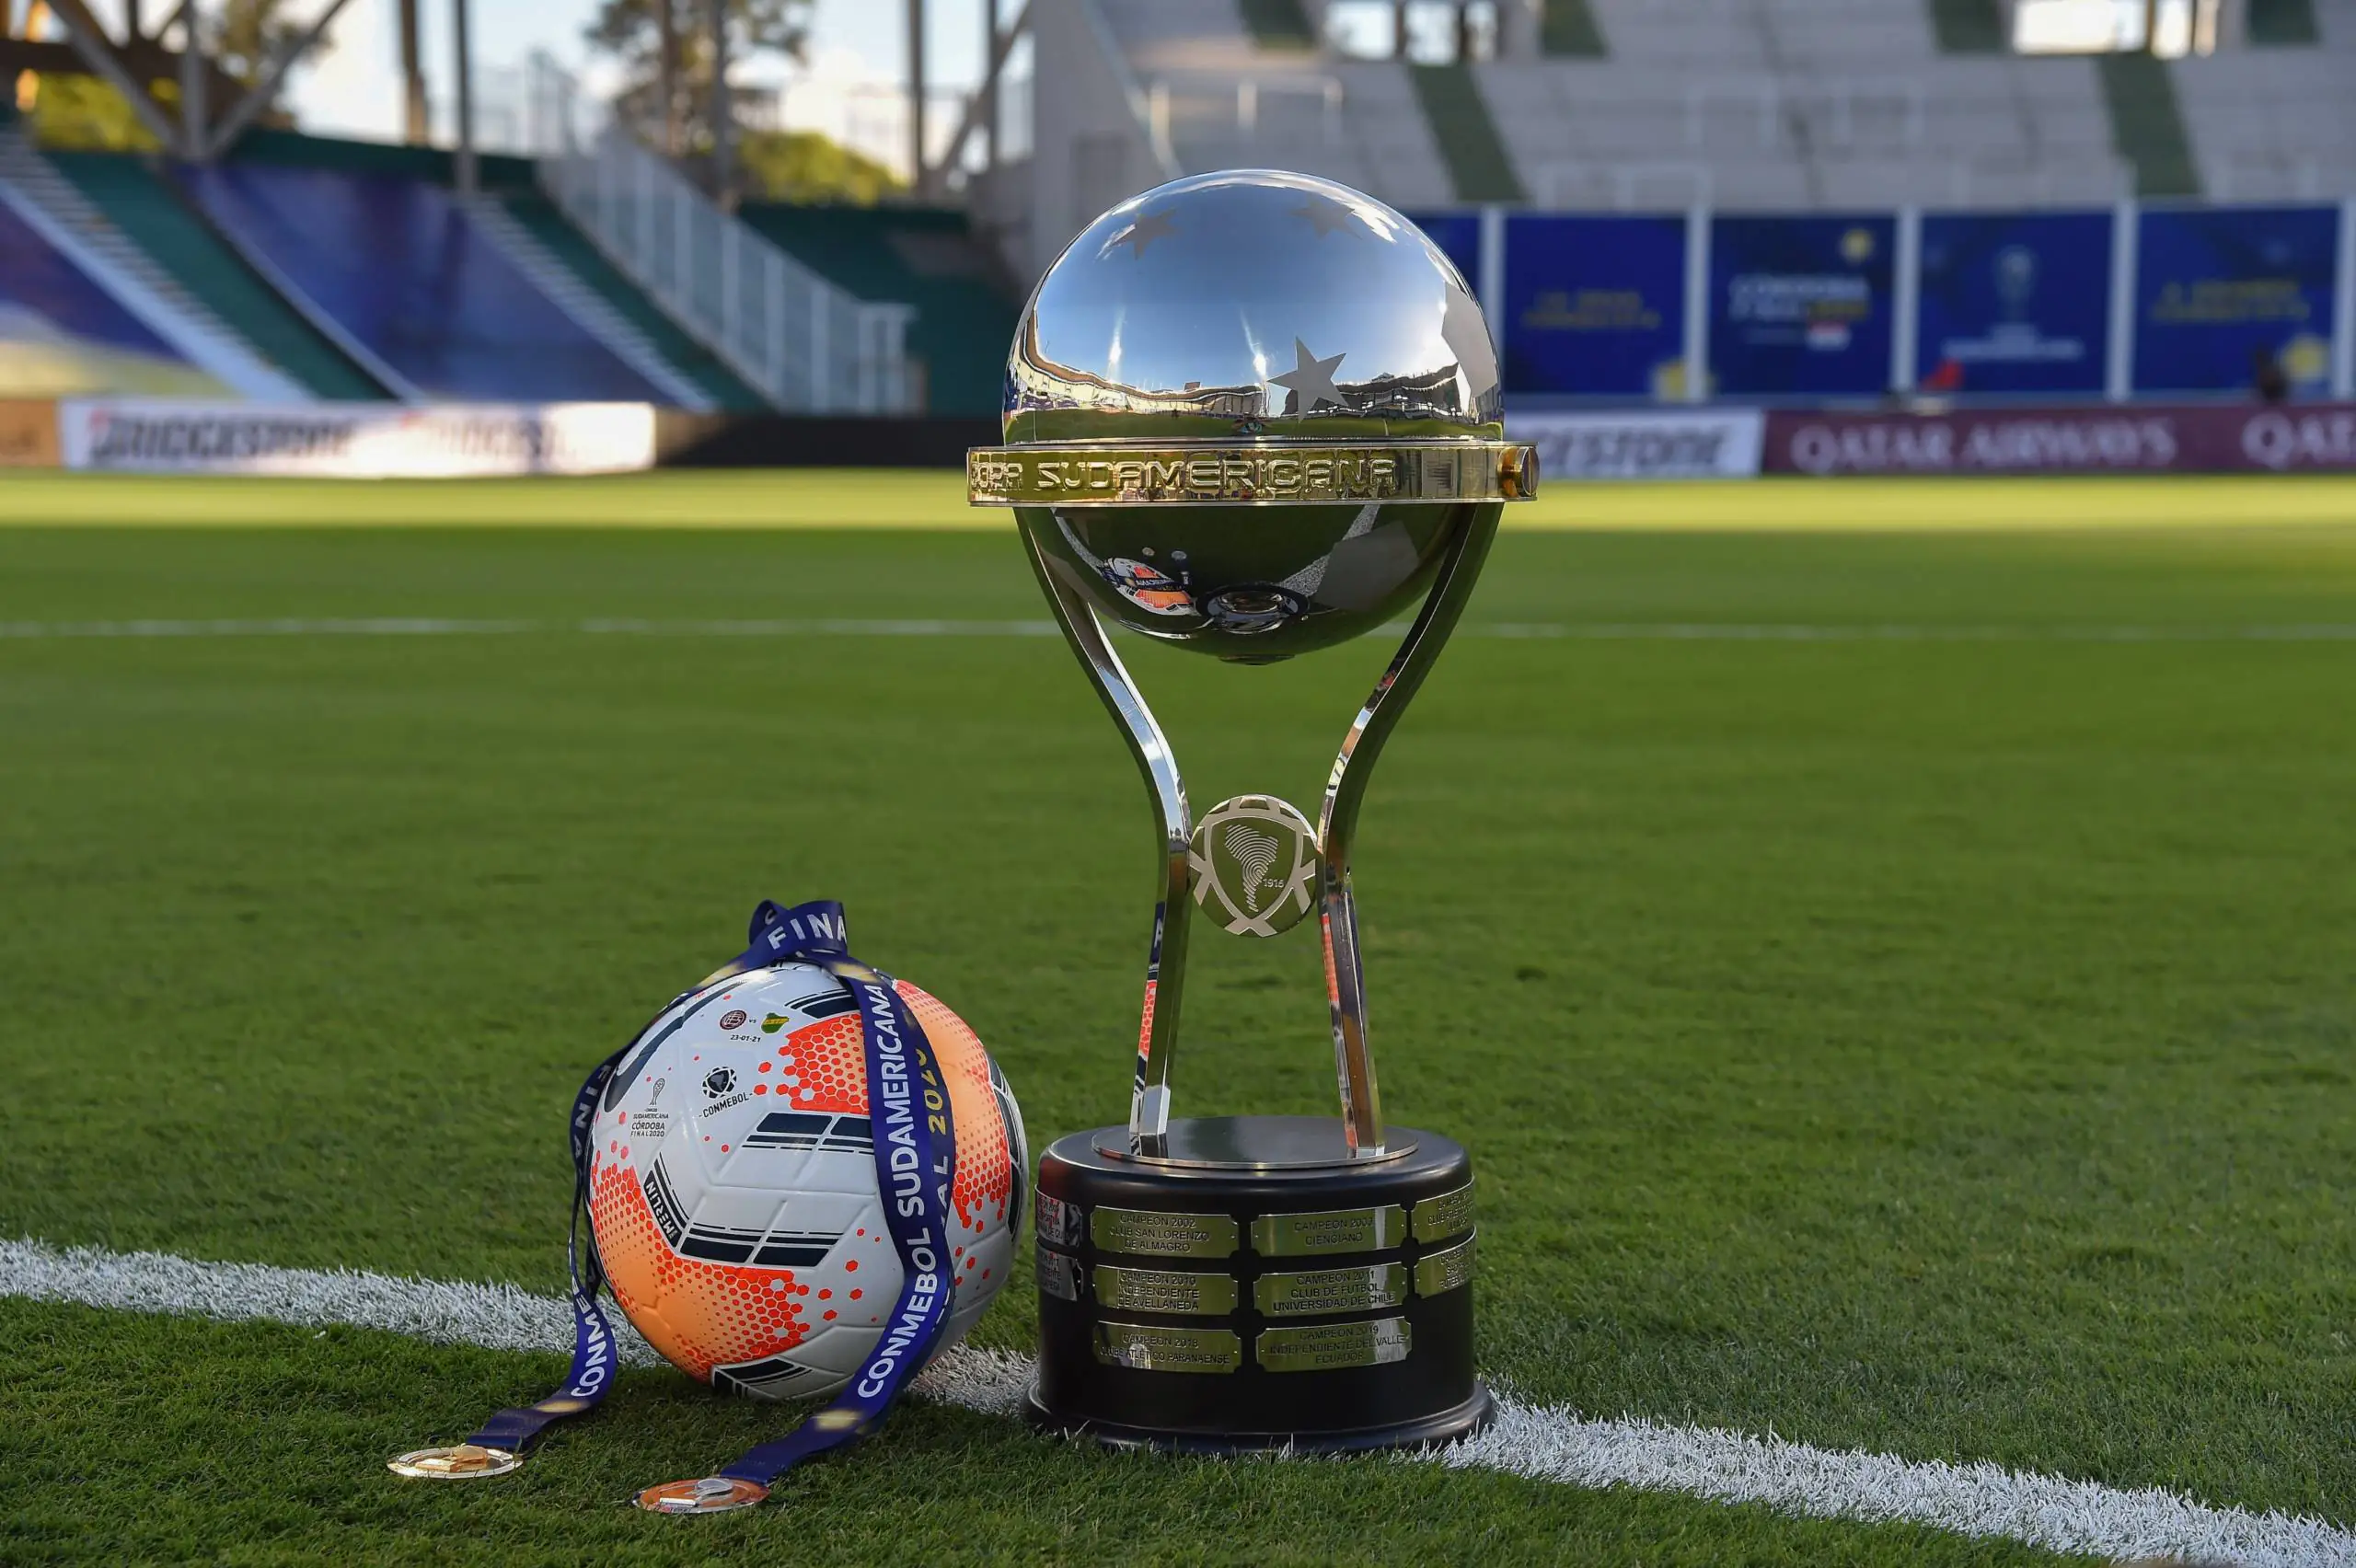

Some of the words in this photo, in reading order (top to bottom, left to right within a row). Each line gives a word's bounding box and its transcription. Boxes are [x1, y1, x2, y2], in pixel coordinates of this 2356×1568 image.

[1037, 460, 1396, 490] SUDAMERICANA
[1262, 878, 1285, 888] 1916
[768, 913, 847, 950] FINA
[730, 1034, 761, 1043] 23-01-21
[865, 985, 925, 1217] SUDAMERICANA
[1120, 1214, 1169, 1227] CAMPEON
[1295, 1220, 1347, 1232] CAMPEON
[1135, 1228, 1156, 1239] SAN
[1159, 1230, 1210, 1241] LORENZO
[1139, 1240, 1191, 1252] ALMAGRO
[1120, 1272, 1169, 1285] CAMPEON
[1296, 1272, 1350, 1285] CAMPEON
[1118, 1284, 1200, 1299] INDEPENDIENTE
[1290, 1288, 1320, 1299] CLUB
[1323, 1286, 1337, 1296] DE
[1341, 1283, 1380, 1295] FUTBOL
[1132, 1297, 1199, 1311] AVELLANEDA
[1273, 1297, 1348, 1312] UNIVERSIDAD
[1351, 1296, 1366, 1306] DE
[1368, 1293, 1396, 1305] CHILE
[858, 1228, 938, 1398] CONMEBOL
[1122, 1333, 1172, 1345] CAMPEON
[1299, 1328, 1353, 1341] CAMPEON
[1375, 1333, 1406, 1346] VALLE
[1168, 1354, 1230, 1365] PARANAENSE
